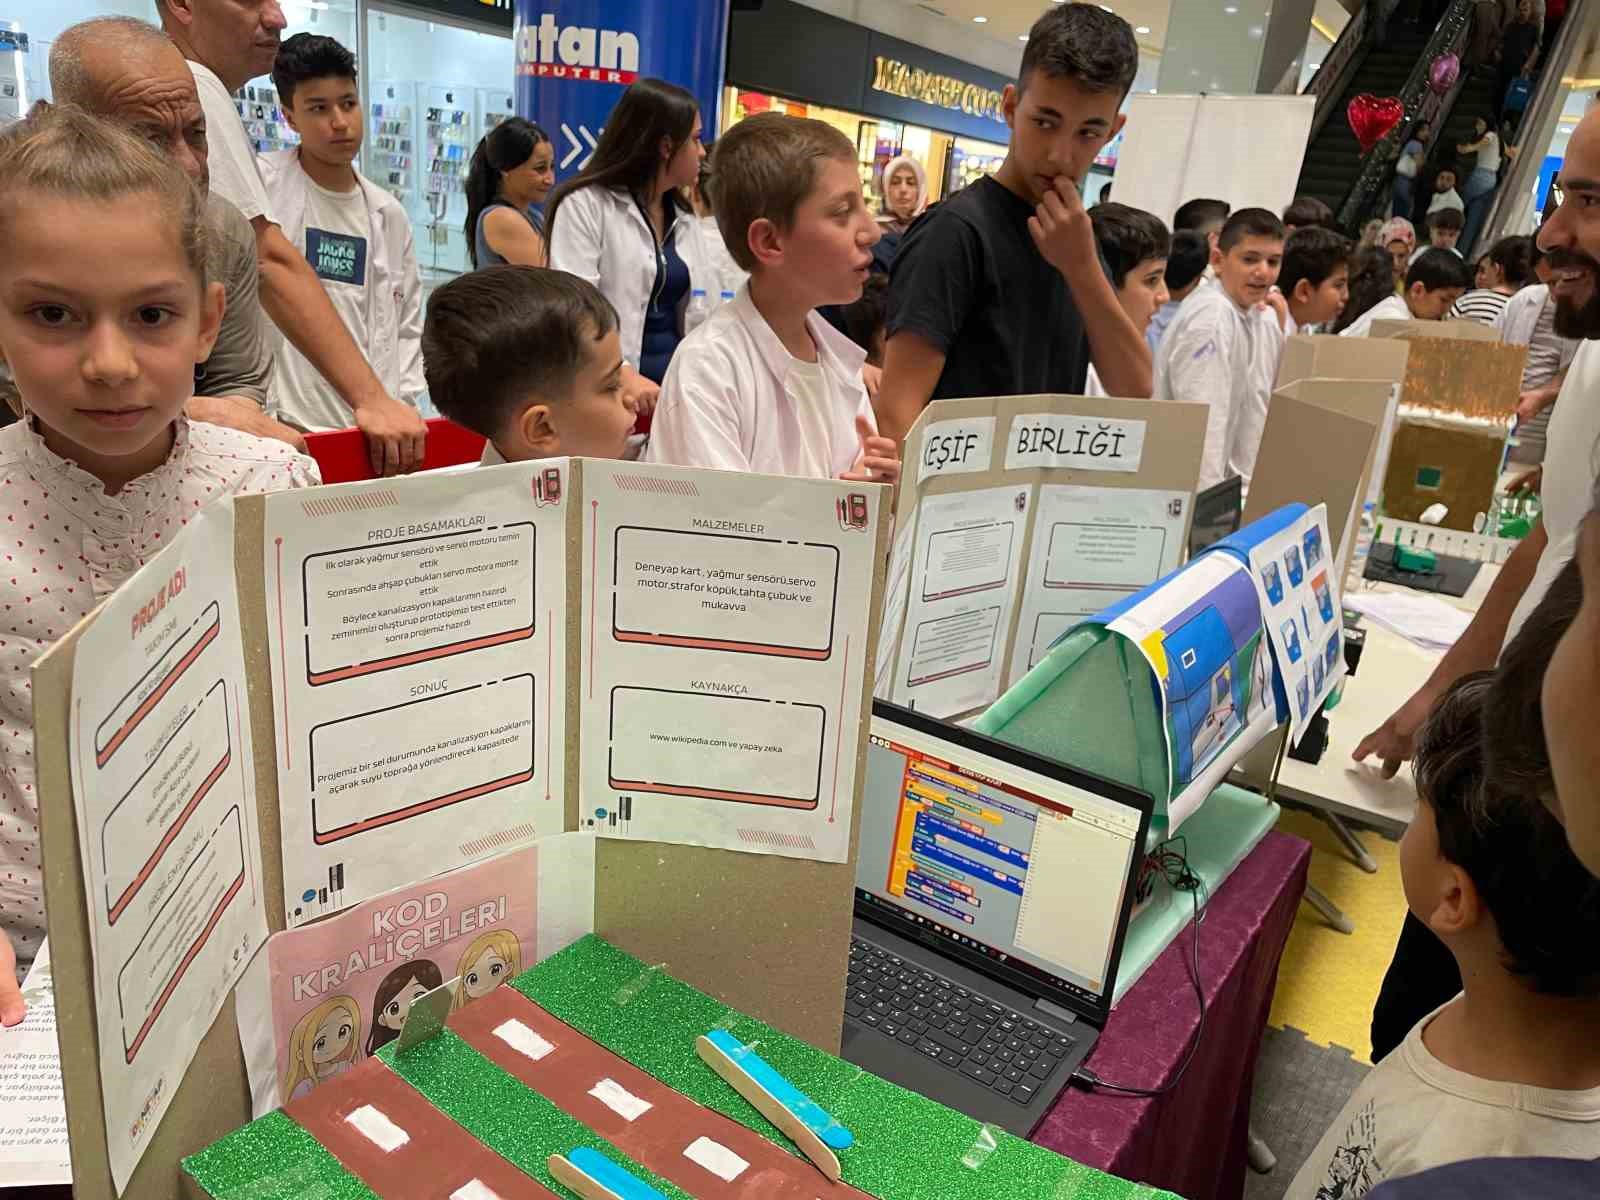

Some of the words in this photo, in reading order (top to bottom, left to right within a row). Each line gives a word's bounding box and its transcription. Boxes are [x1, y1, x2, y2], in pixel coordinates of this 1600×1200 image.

[514, 13, 640, 72] atan
[1017, 421, 1126, 458] BİRLİĞİ
[367, 526, 405, 541] PROJE
[408, 515, 486, 535] BASAMAKLARI
[692, 518, 764, 534] MALZEMELER
[337, 557, 366, 567] olarak
[366, 551, 399, 565] yağmur
[446, 541, 468, 551] servo
[419, 560, 439, 569] ettik
[635, 562, 679, 575] Deneyap
[706, 568, 744, 580] yağmur
[378, 578, 403, 590] ahşap
[443, 567, 464, 578] servo
[465, 563, 493, 574] motora
[494, 559, 519, 568] monte
[419, 586, 439, 596] ettik
[767, 591, 798, 601] çubuk
[800, 595, 812, 603] ve
[470, 603, 486, 612] test
[486, 598, 516, 609] ettikten
[701, 600, 746, 612] mukavva
[385, 632, 409, 643] sonra
[410, 679, 448, 697] SONUÇ
[690, 680, 749, 695] KAYNAKÇA
[739, 742, 763, 753] yapay
[763, 744, 783, 753] zeka
[318, 767, 358, 783] Projemiz
[359, 763, 372, 772] bir
[372, 758, 385, 768] sel
[386, 744, 436, 764] durumunda
[437, 731, 489, 749] kanalizasyon
[328, 780, 359, 794] açarak
[361, 773, 383, 785] suyu
[383, 763, 418, 778] toprağa
[371, 891, 449, 938] KOD
